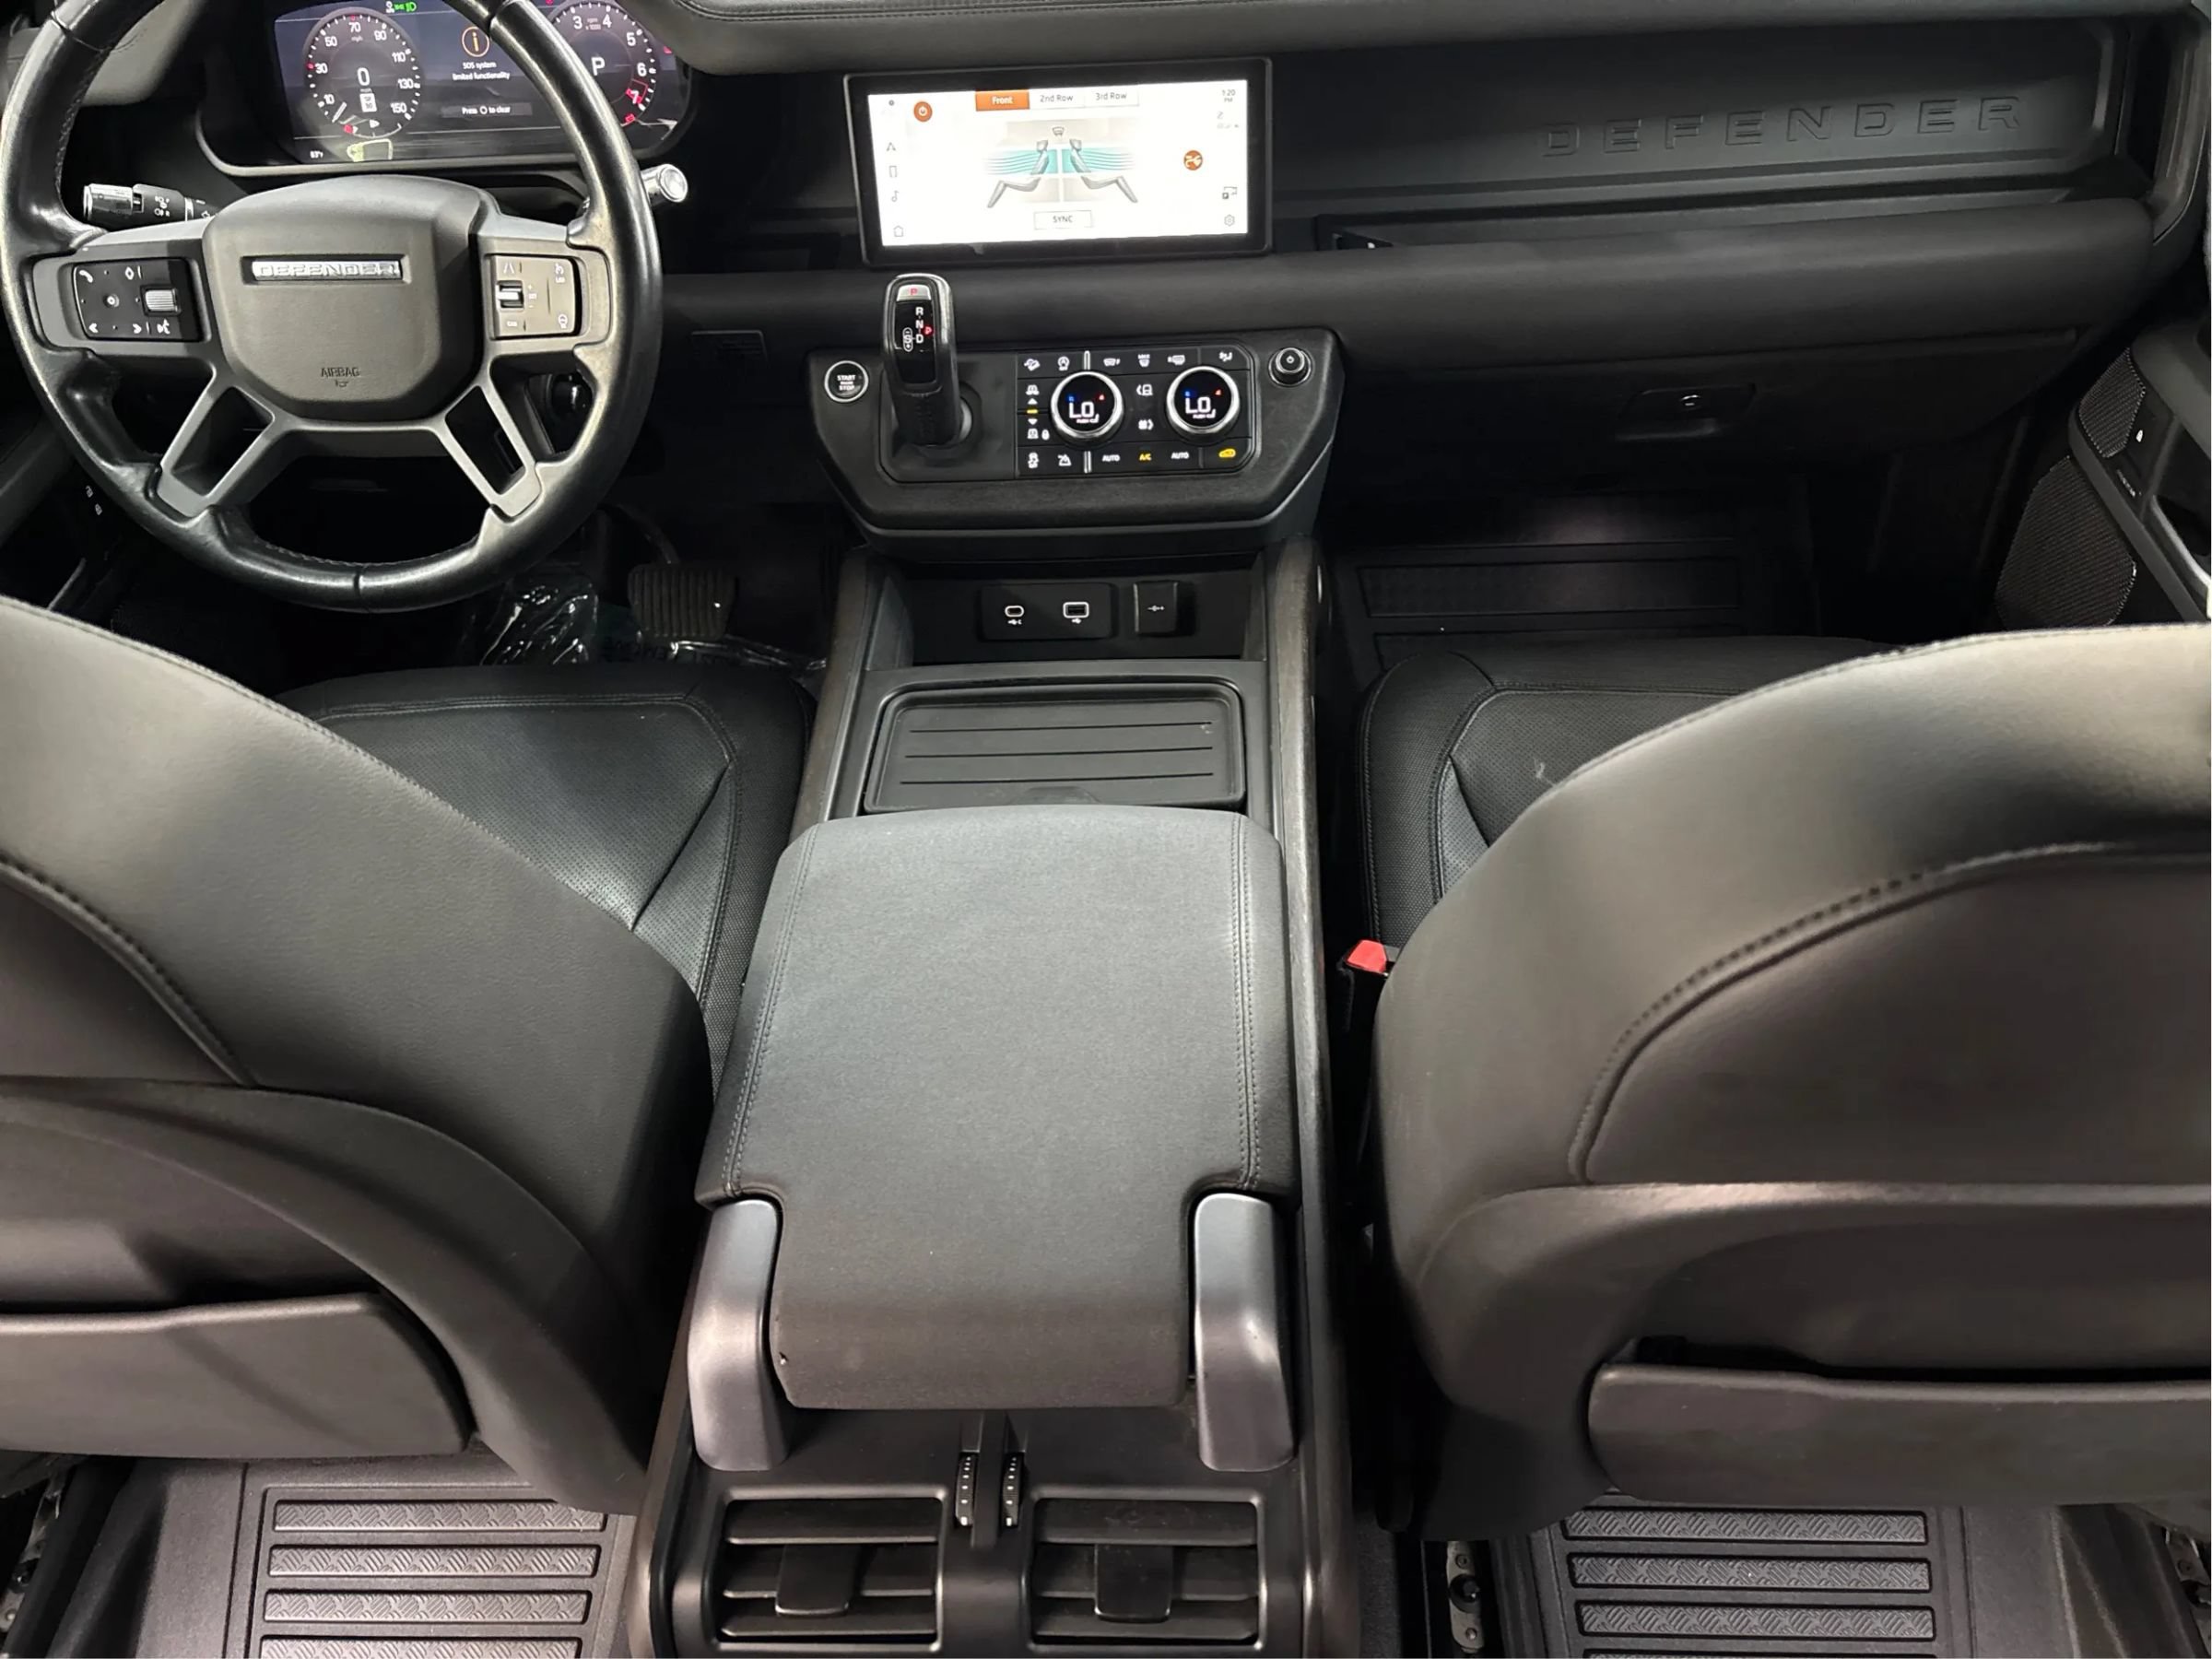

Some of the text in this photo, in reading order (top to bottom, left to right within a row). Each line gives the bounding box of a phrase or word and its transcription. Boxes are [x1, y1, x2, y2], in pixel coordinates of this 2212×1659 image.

[348, 21, 361, 33] 70
[572, 16, 582, 29] 3
[602, 14, 612, 29] 4
[324, 36, 338, 47] 50
[627, 32, 636, 47] 5
[392, 52, 406, 63] 110
[314, 63, 328, 74] 30
[463, 61, 497, 70] SOS system
[591, 56, 606, 76] P
[637, 62, 647, 76] 6
[357, 67, 371, 86] 0
[452, 71, 511, 81] limited functionality
[397, 78, 414, 89] 130
[324, 94, 335, 105] 10
[630, 89, 640, 104] 7
[992, 96, 1014, 105] Front
[1040, 94, 1074, 103] 2nd Row
[1095, 91, 1127, 100] 3rd Row
[390, 102, 407, 113] 150
[462, 105, 511, 115] Press to clear
[1540, 95, 2022, 158] DEFENDER
[1053, 215, 1073, 223] SYNC
[256, 263, 400, 278] DEFENDER
[910, 288, 918, 296] P
[915, 306, 924, 316] R
[915, 319, 924, 329] N
[924, 326, 933, 335] P
[915, 334, 924, 344] D
[320, 366, 360, 378] AIRBAG
[1068, 401, 1095, 419] LO
[1184, 396, 1212, 415] LO
[1101, 454, 1121, 463] AUTO
[1138, 453, 1152, 462] A/C
[1171, 451, 1190, 460] AUTO
